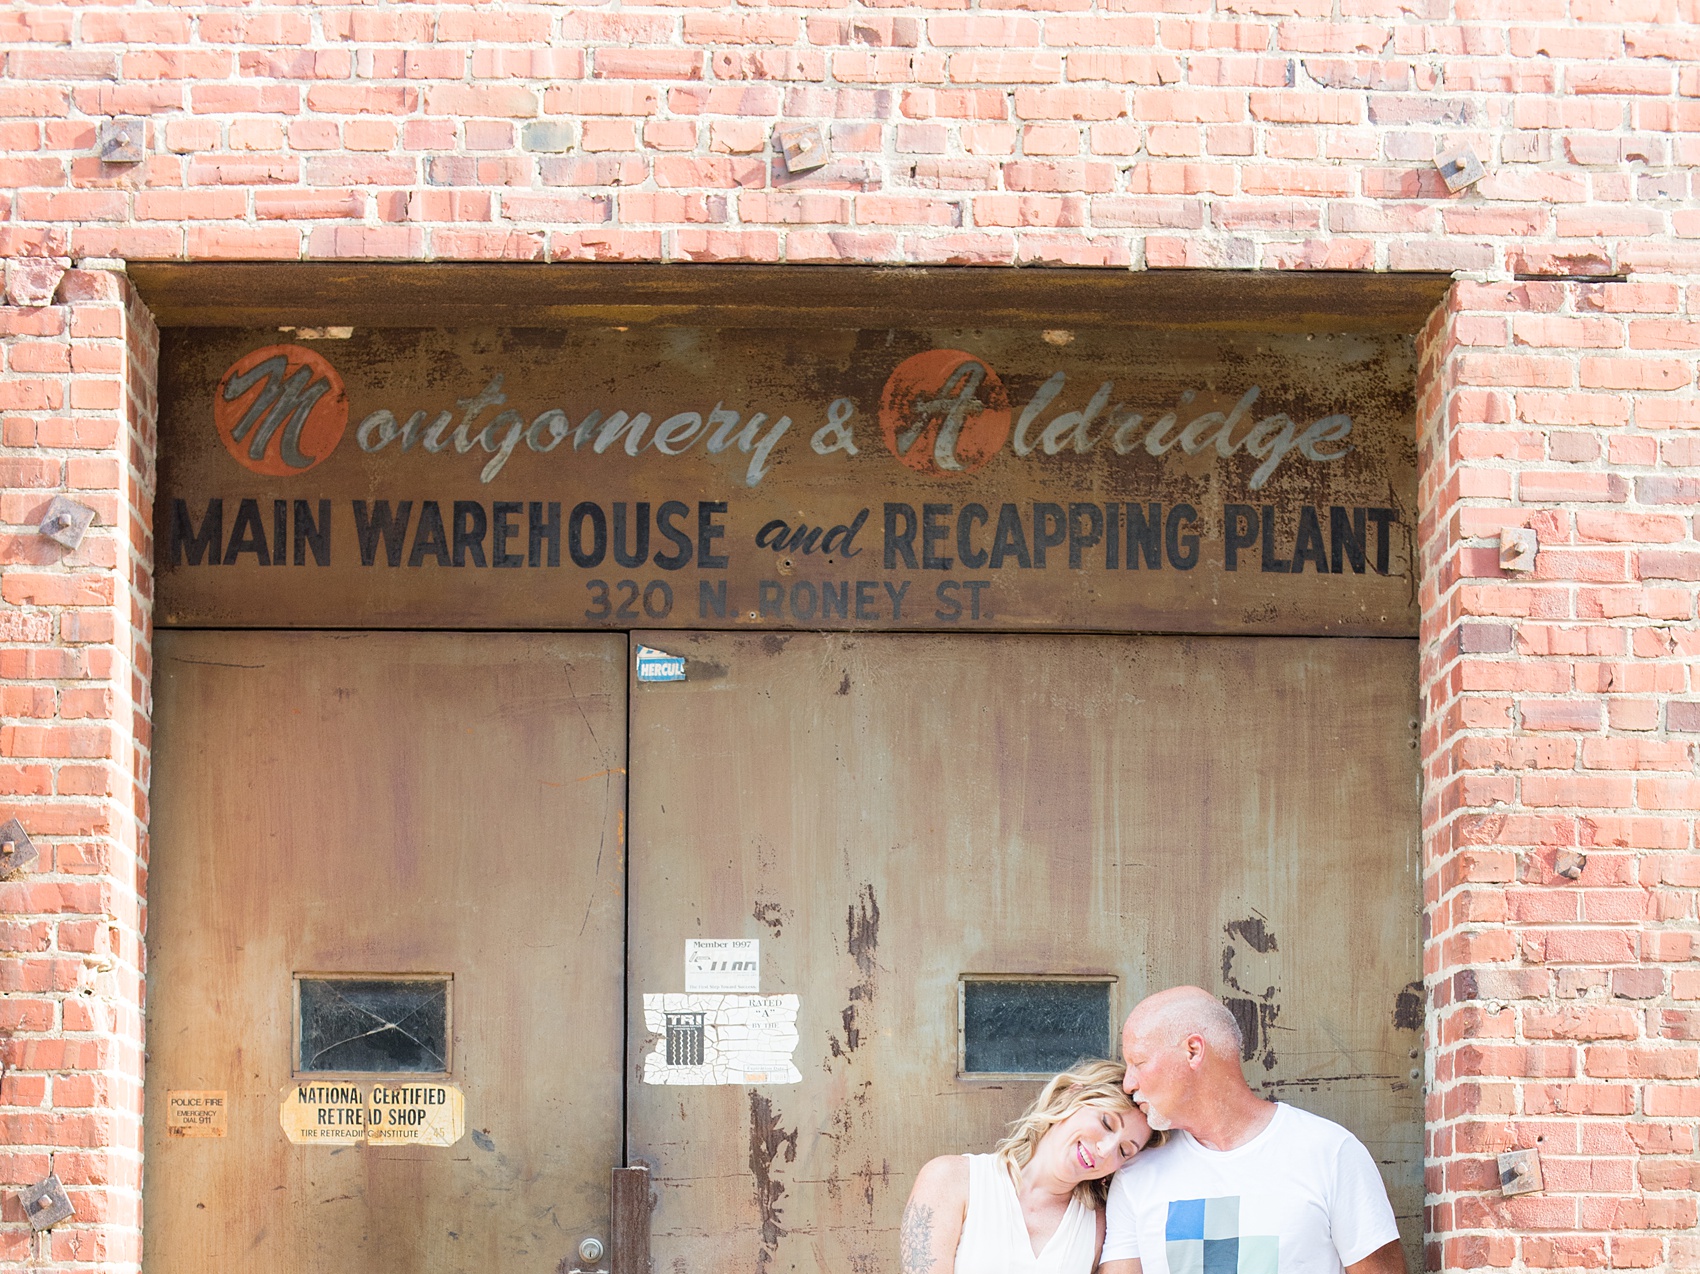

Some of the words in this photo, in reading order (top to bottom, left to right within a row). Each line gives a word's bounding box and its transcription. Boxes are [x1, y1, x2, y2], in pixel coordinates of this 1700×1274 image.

[224, 354, 792, 487] Montgomery
[809, 398, 859, 456] &
[899, 360, 1354, 490] Aldridge
[171, 498, 332, 567] MAIN
[352, 500, 729, 570] WAREHOUSE
[755, 507, 870, 558] and
[883, 502, 1200, 571] RECAPPING
[1223, 504, 1402, 574] PLANT
[585, 579, 674, 620] 320
[699, 580, 739, 618] N.
[758, 580, 912, 620] RONEY
[934, 580, 995, 621] ST.
[667, 1015, 702, 1025] TRI
[373, 1087, 446, 1105] CERTIFIED
[199, 1116, 212, 1124] 911
[388, 1108, 426, 1126] SHOP
[301, 1129, 318, 1137] TIRE
